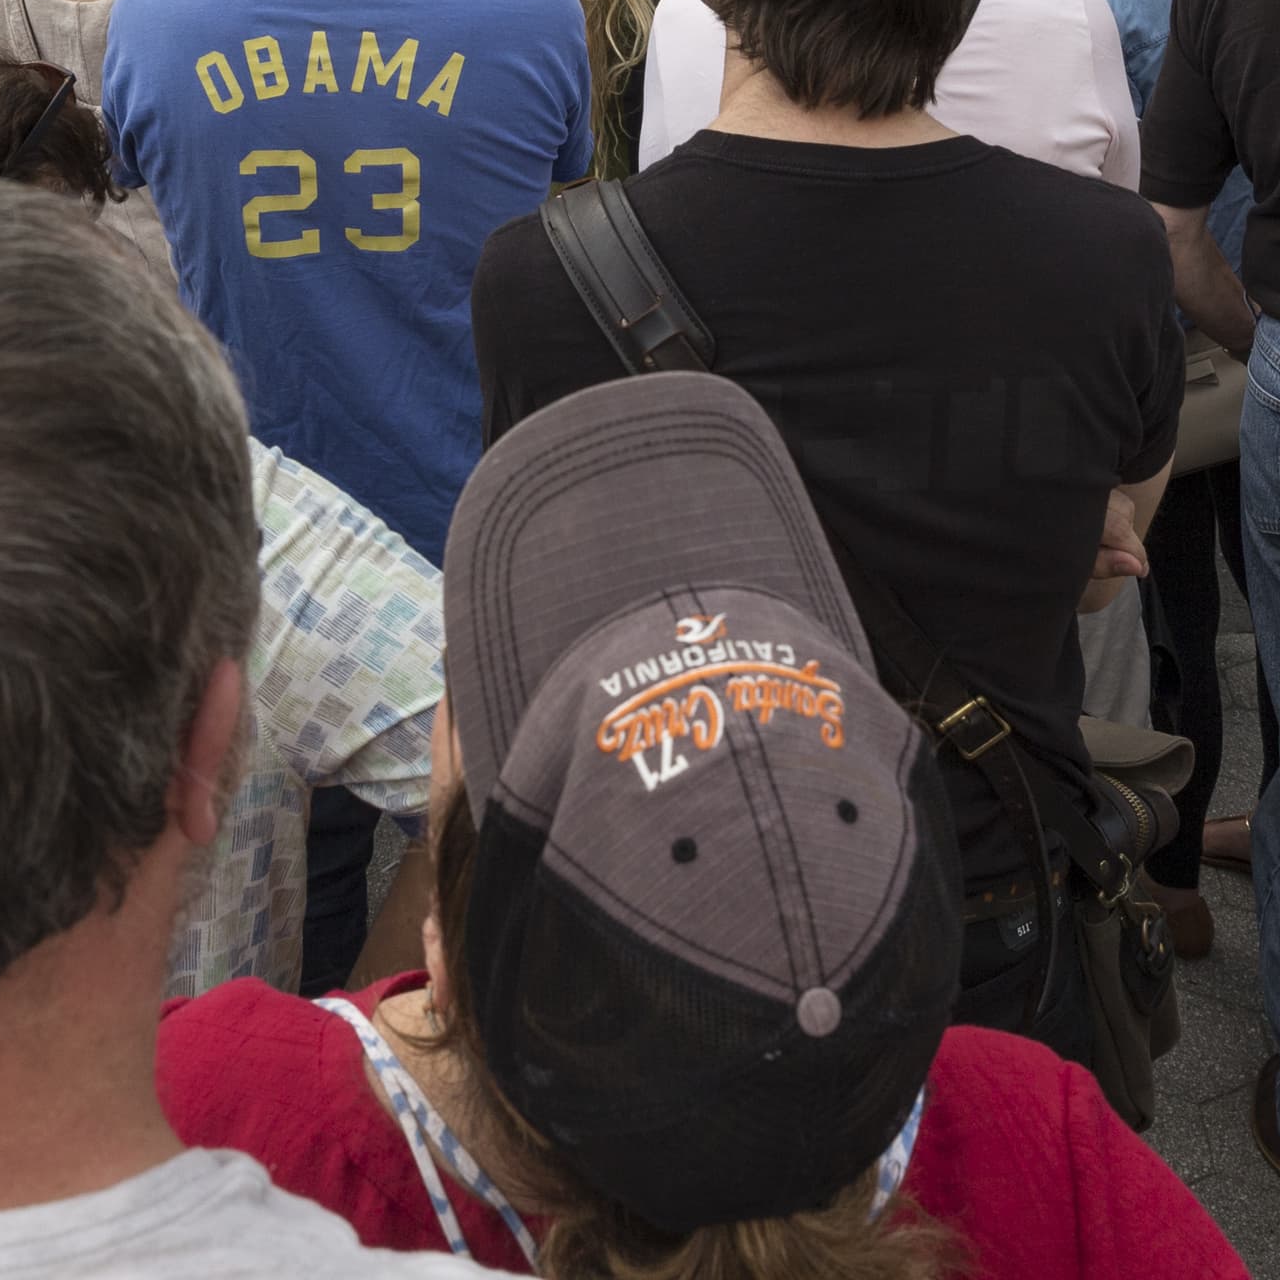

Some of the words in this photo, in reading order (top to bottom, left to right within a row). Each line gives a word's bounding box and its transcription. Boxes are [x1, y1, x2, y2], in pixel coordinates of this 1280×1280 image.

[195, 31, 465, 117] OBAMA
[239, 147, 420, 259] 23
[600, 639, 796, 696] CALIFORNIA
[597, 684, 725, 762] Cruz
[726, 674, 845, 750] Santa
